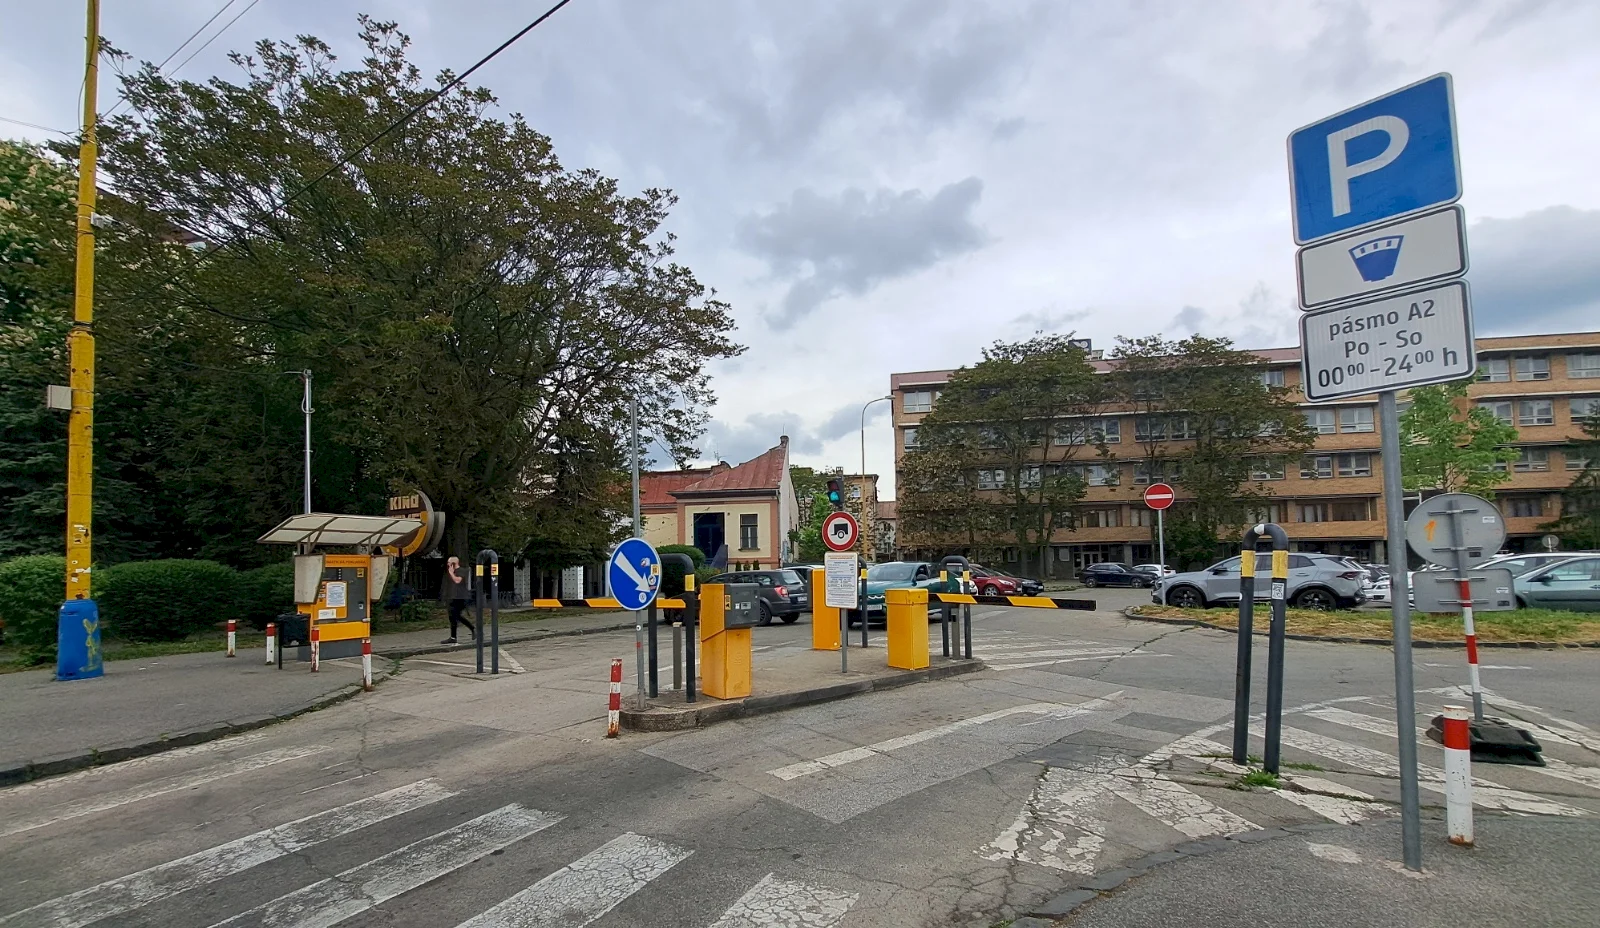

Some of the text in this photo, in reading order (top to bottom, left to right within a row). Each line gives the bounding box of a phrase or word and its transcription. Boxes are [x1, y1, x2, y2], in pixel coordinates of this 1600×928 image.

[1327, 115, 1410, 217] P
[1329, 299, 1435, 341] pásmo A2
[1345, 340, 1369, 358] Po
[1396, 330, 1422, 348] So
[1443, 347, 1458, 367] h
[390, 494, 419, 510] KINO
